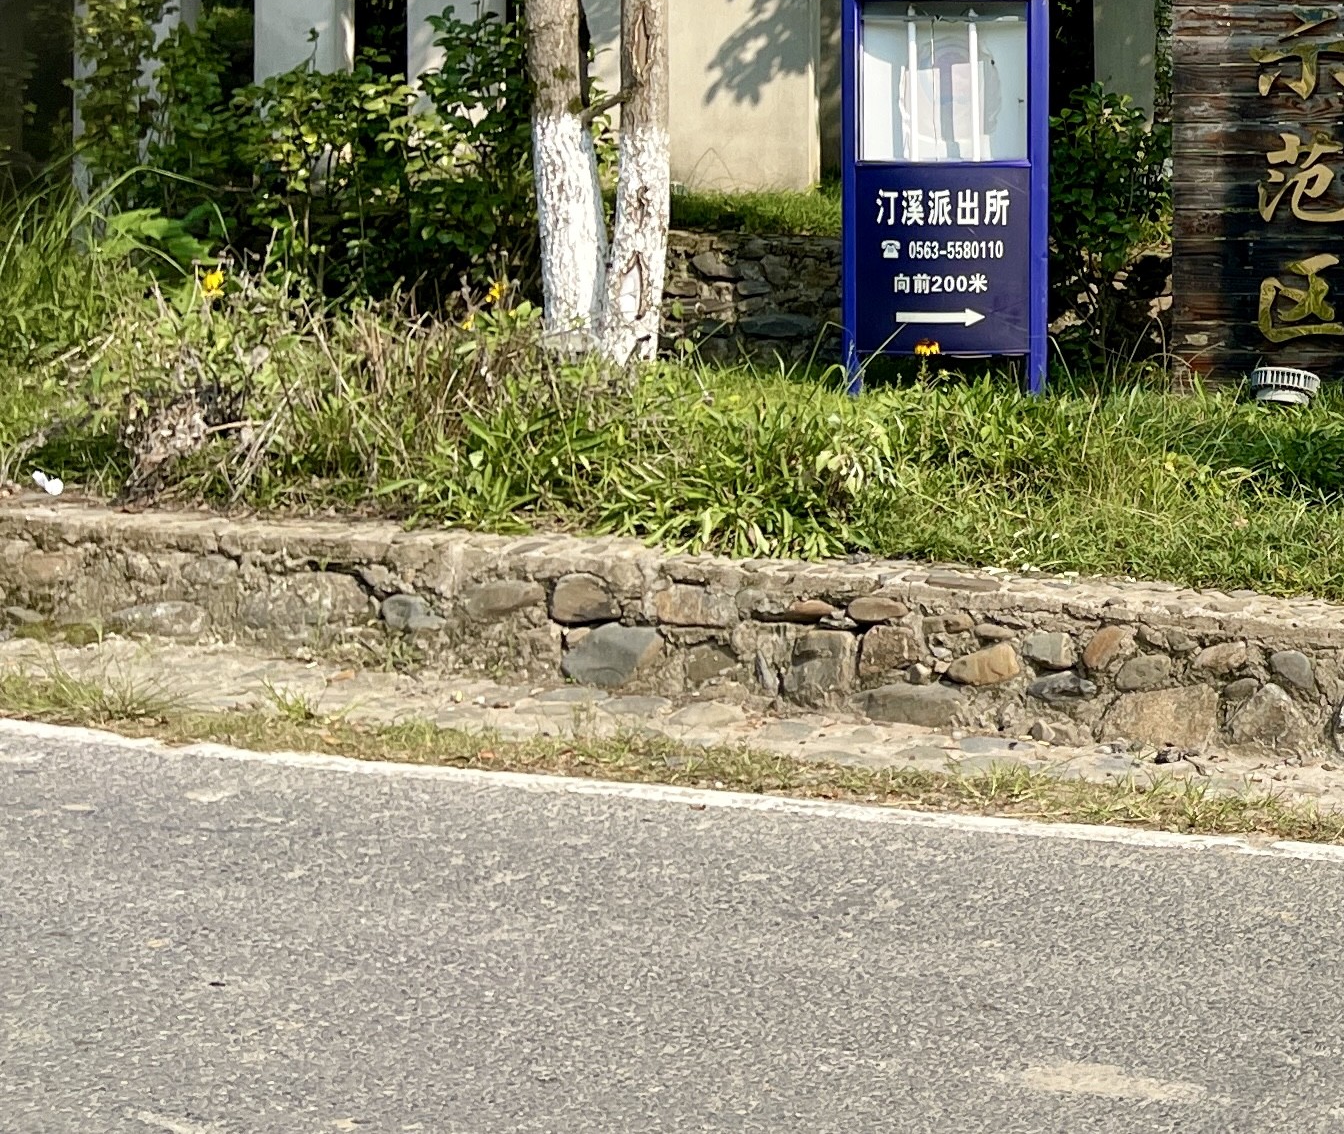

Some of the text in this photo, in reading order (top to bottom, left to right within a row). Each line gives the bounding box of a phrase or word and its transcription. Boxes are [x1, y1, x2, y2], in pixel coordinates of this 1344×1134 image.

[876, 188, 1010, 227] 汀溪派出所
[908, 240, 1004, 260] 0563-5580110
[893, 273, 989, 294] 向前200米
